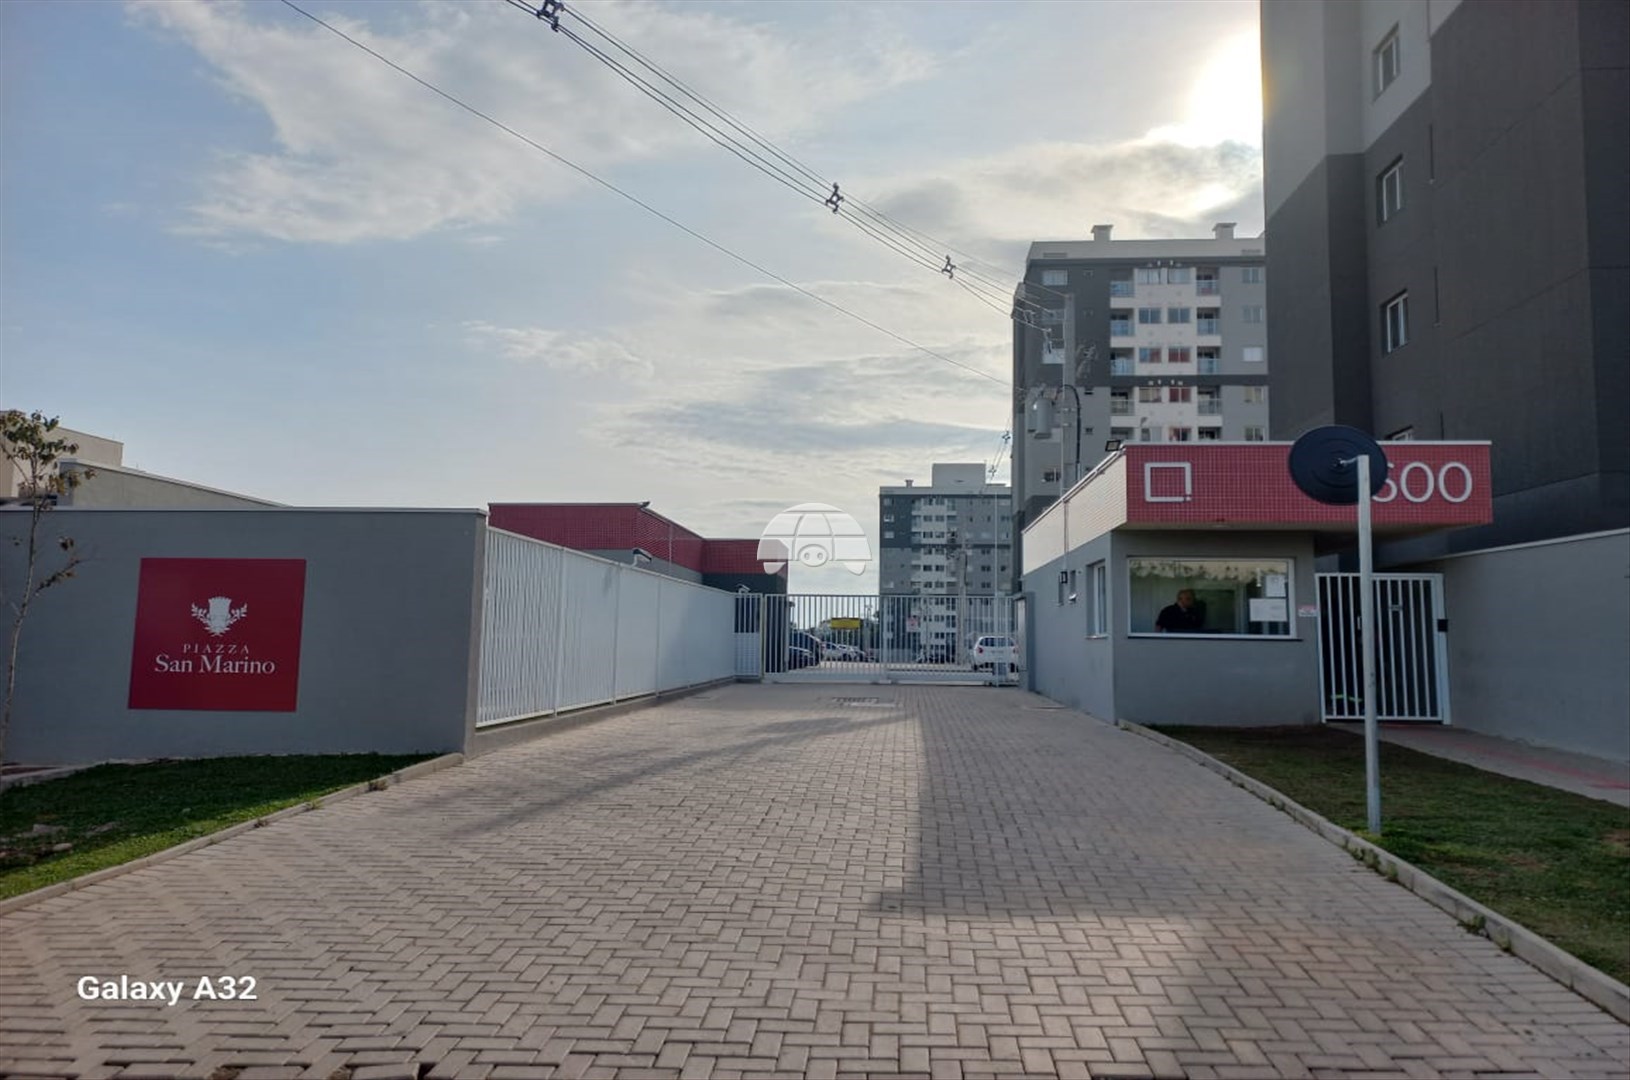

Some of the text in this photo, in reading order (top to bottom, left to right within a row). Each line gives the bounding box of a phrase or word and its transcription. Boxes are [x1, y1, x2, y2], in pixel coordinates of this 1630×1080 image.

[184, 643, 249, 654] PIAZZA
[155, 654, 275, 674] San Marino
